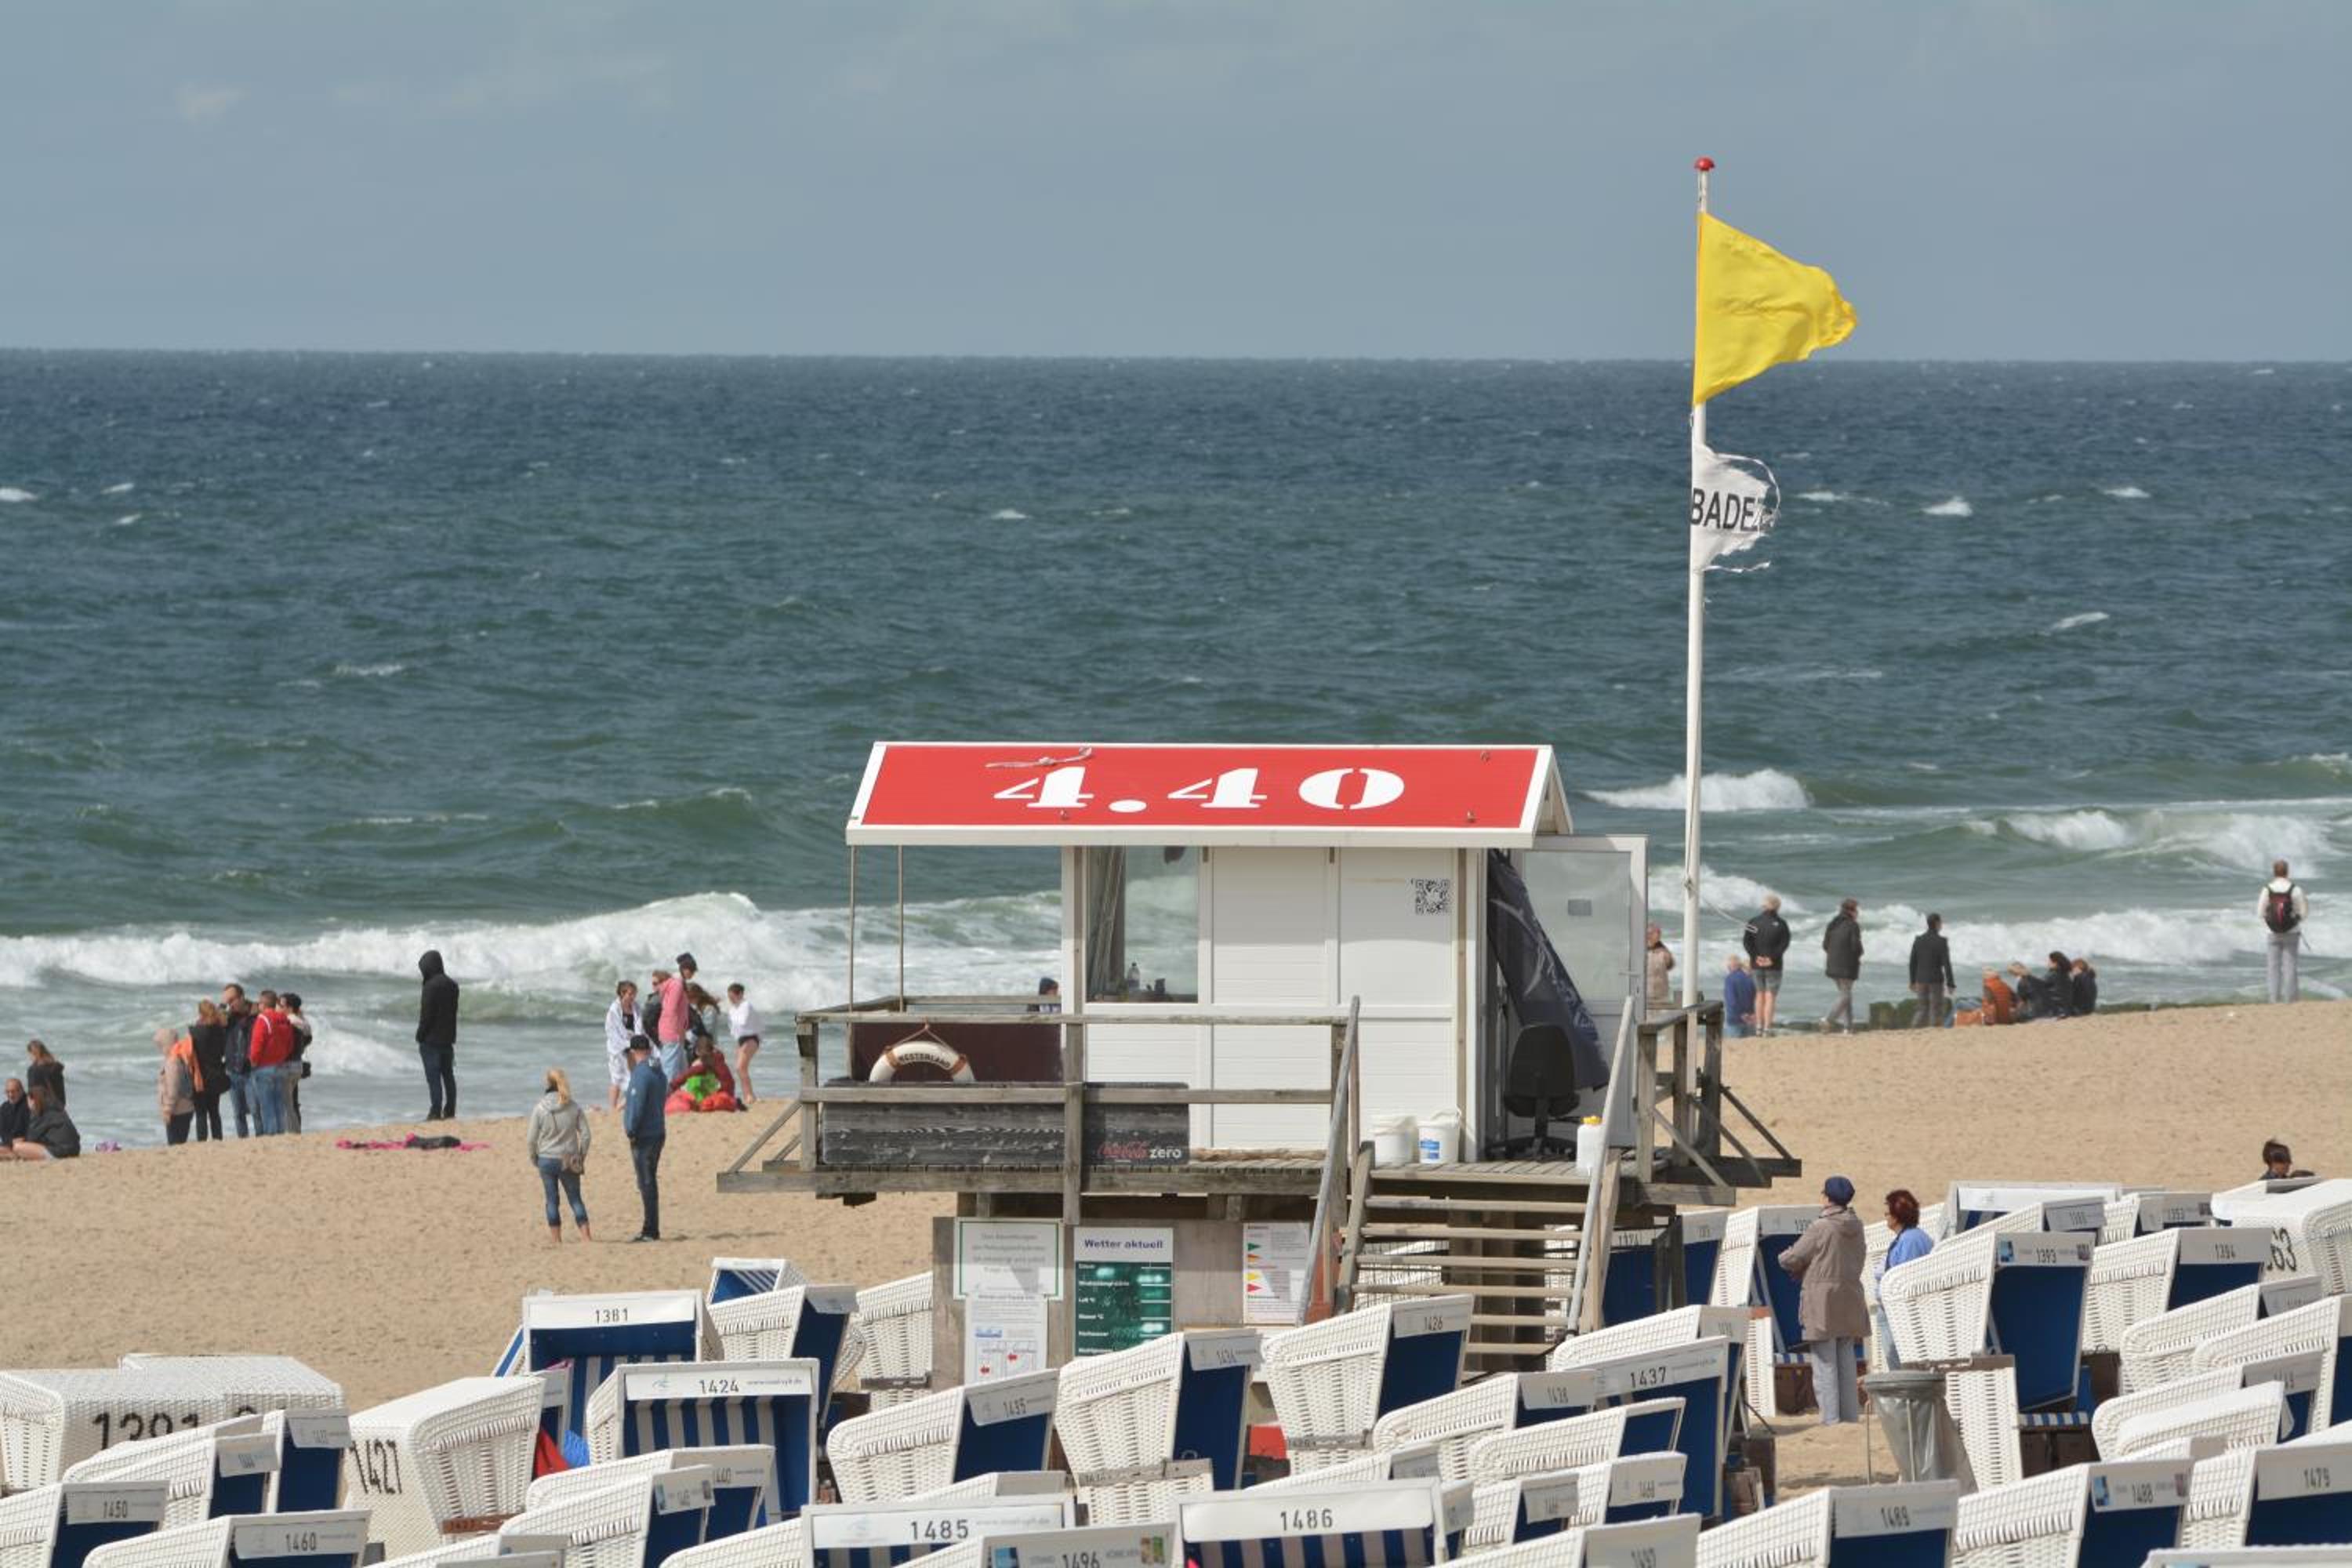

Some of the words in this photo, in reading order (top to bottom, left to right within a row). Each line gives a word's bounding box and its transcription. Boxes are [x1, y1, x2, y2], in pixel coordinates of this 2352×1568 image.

[1691, 488, 1773, 532] BADE
[993, 765, 1405, 814] 4.40
[1084, 1239, 1121, 1249] Wetter
[1124, 1239, 1163, 1249] aktuell
[595, 1308, 628, 1324] 1381
[699, 1379, 739, 1394] 1424
[1630, 1367, 1667, 1388] 1437
[911, 1519, 970, 1541] 1485
[1280, 1508, 1334, 1531] 1486
[285, 1532, 318, 1552] 1460
